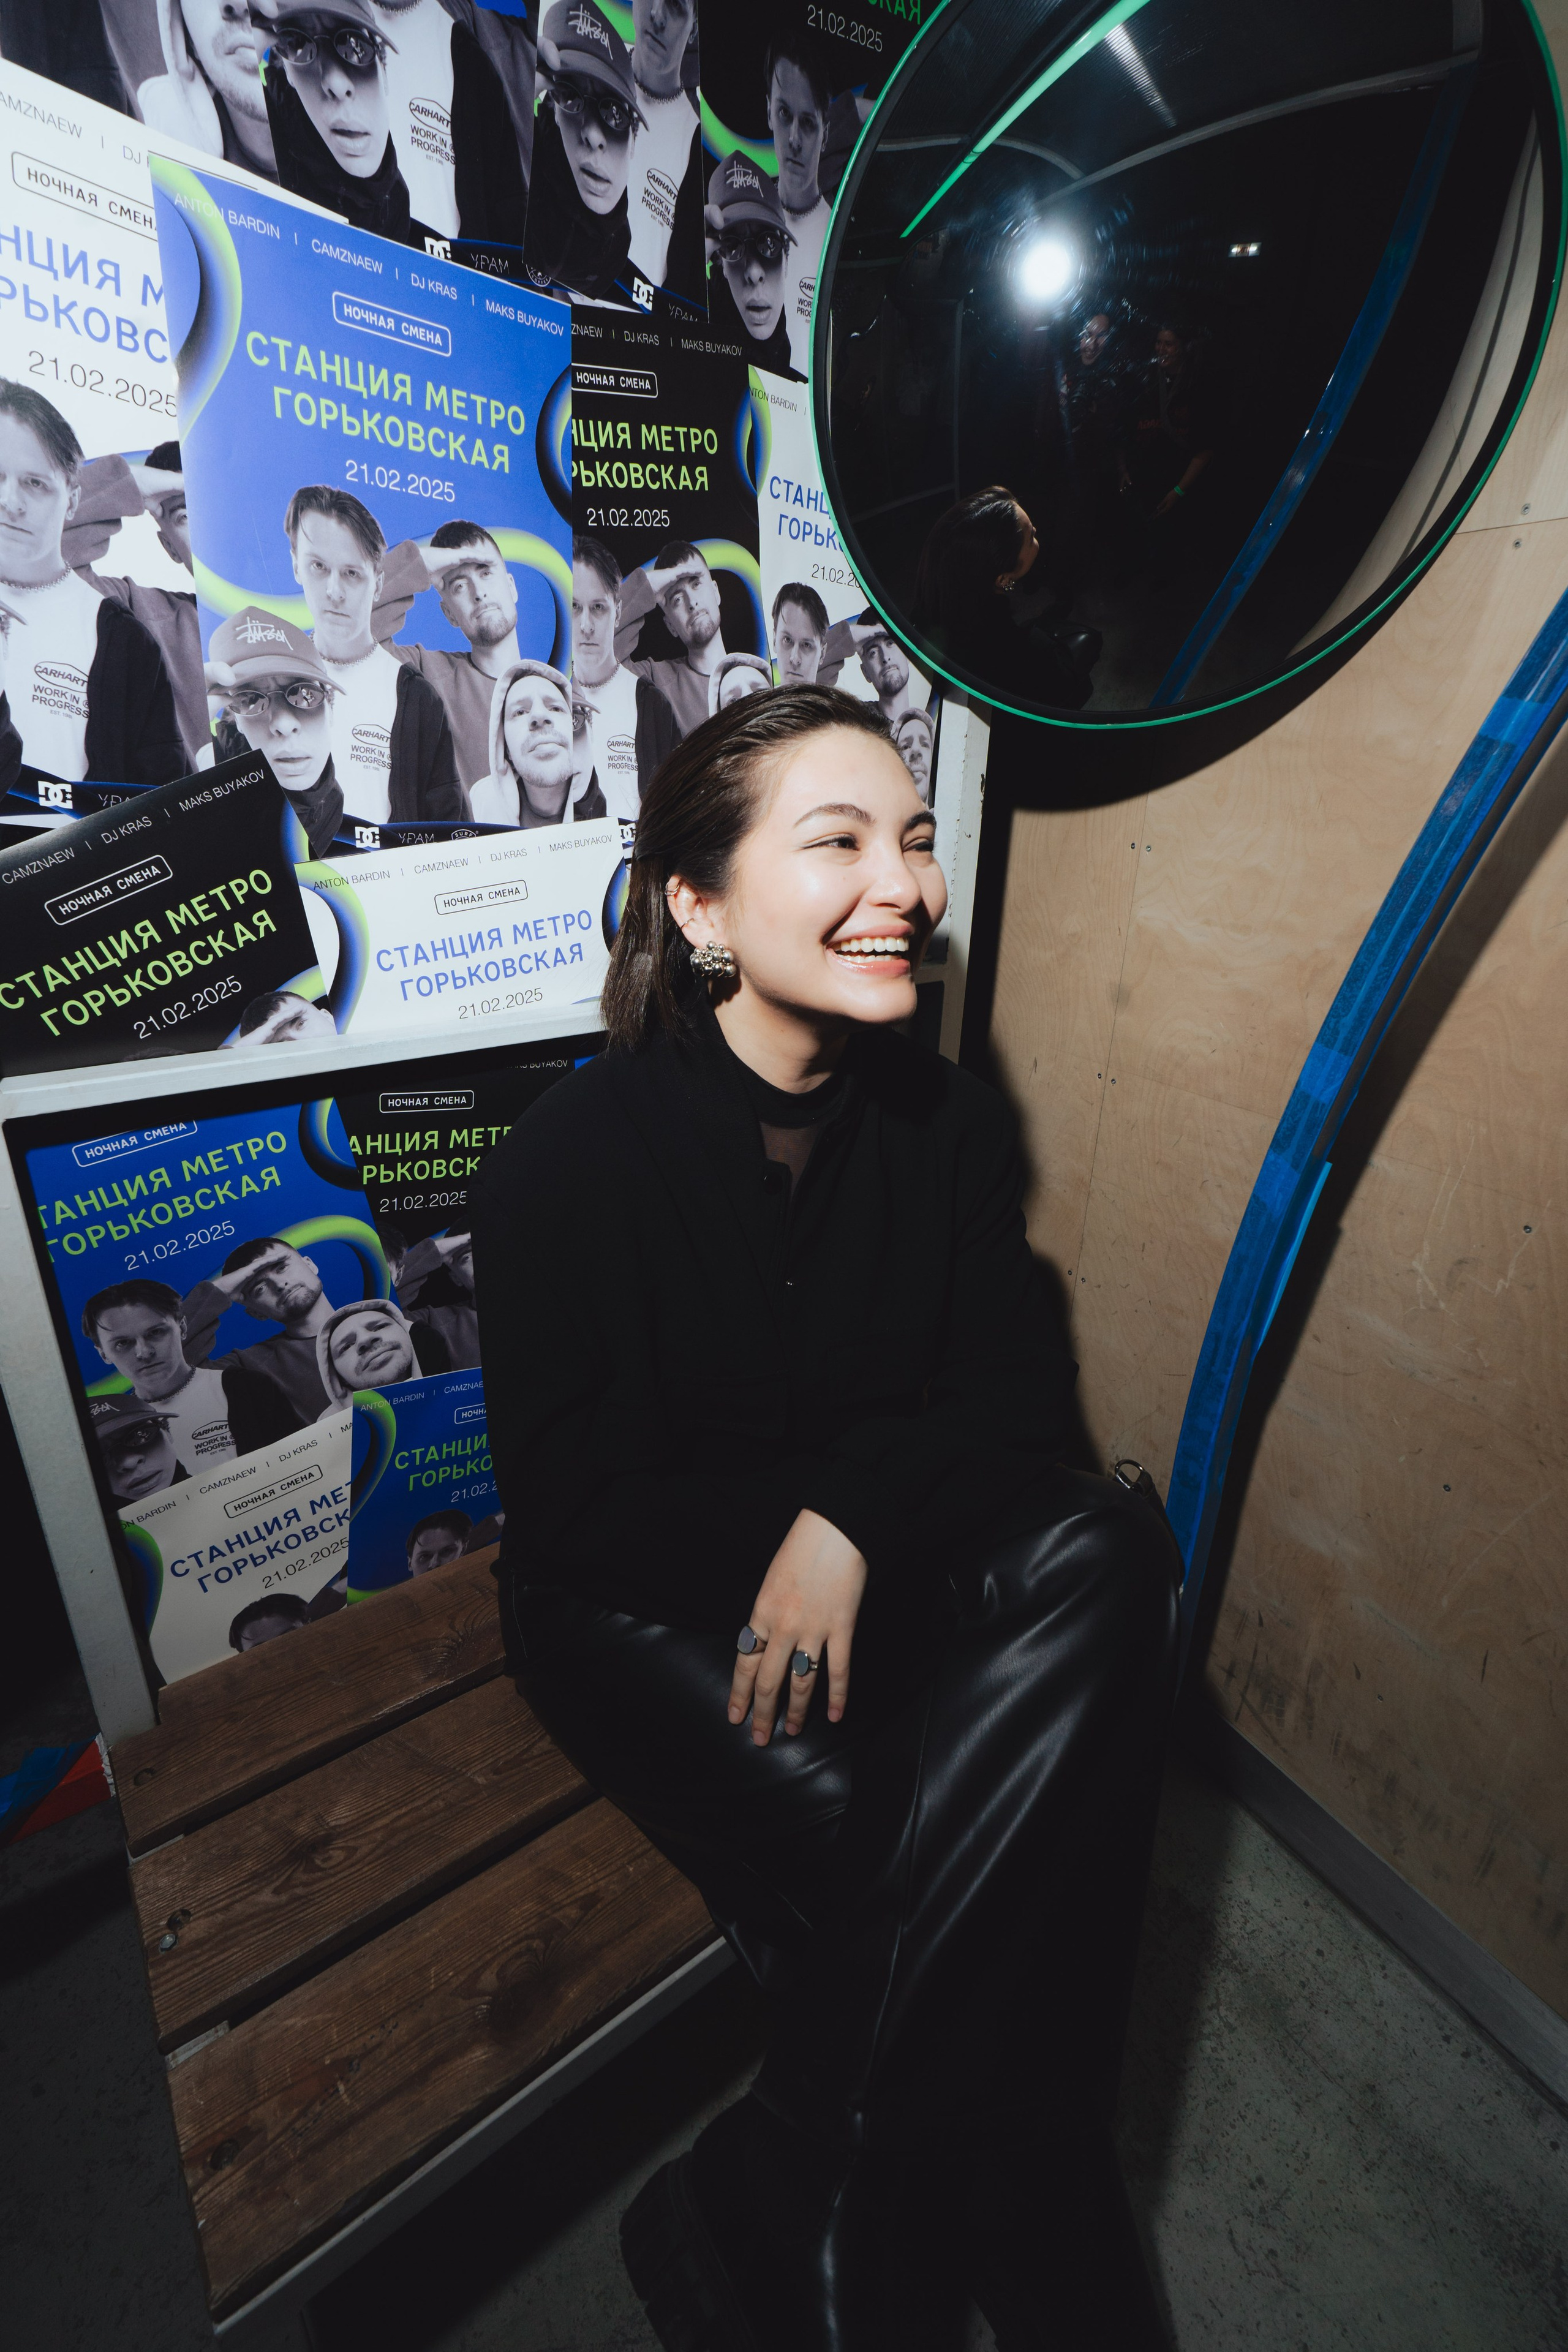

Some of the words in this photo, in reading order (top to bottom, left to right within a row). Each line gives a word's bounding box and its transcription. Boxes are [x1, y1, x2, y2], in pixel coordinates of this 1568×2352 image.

[807, 4, 883, 52] 21.02.2025
[123, 145, 141, 164] DJ
[410, 124, 438, 143] WORK
[439, 136, 447, 148] IN
[411, 136, 456, 165] PROGRESS
[28, 167, 97, 206] НОЧНАЯ
[109, 201, 157, 231] СМЕН
[642, 196, 674, 230] PROGRESS
[644, 187, 665, 208] WORK
[665, 204, 671, 216] IN
[175, 193, 224, 221] ANTON
[229, 211, 279, 239] BARDIN
[311, 239, 382, 274] CAMZNAEW
[411, 273, 425, 289] DJ
[428, 279, 457, 300] KRAS
[486, 300, 514, 320] MAKS
[517, 311, 564, 336] BUYAKOV
[344, 303, 394, 331] НОЧНАЯ
[401, 322, 442, 346] СМЕНА
[624, 331, 635, 342] DJ
[637, 332, 660, 346] KRAS
[681, 338, 704, 352] MAKS
[706, 342, 742, 356] BUYAKOV
[29, 350, 177, 417] 21.02.2025
[246, 331, 412, 405] СТАНЦИЯ
[425, 381, 526, 435] МЕТРО
[576, 372, 615, 386] НОЧНАЯ
[620, 376, 651, 390] СМЕНА
[771, 394, 797, 412] BARDIN
[273, 386, 510, 473] ГОРЬКОВСКАЯ
[641, 424, 718, 454] МЕТРО
[345, 460, 456, 502] 21.02.2025
[587, 508, 670, 527] 21.02.2025
[778, 513, 843, 552] ГОРЬК
[32, 695, 89, 718] PROGRESS
[33, 684, 68, 699] WORK
[70, 693, 80, 704] IN
[350, 753, 392, 769] PROGRESS
[352, 745, 377, 755] WORK
[377, 749, 385, 758] IN
[608, 763, 639, 772] PROGRESS
[2, 847, 75, 884] CAMZNAEW
[101, 829, 119, 843] DJ
[118, 816, 152, 837] KRAS
[179, 791, 213, 812] MAKS
[212, 769, 264, 798] BUYAKOV
[313, 876, 349, 891] ANTON
[351, 870, 391, 884] BARDIN
[414, 858, 469, 875] CAMZNAEW
[490, 853, 502, 862] DJ
[503, 848, 527, 859] KRAS
[549, 841, 573, 852] MAKS
[575, 835, 612, 848] BUYAKOV
[58, 885, 113, 915] НОЧНАЯ
[116, 865, 161, 890] СМЕНА
[443, 893, 483, 908] НОЧНАЯ
[488, 887, 521, 899] СМЕНА
[0, 919, 162, 1009] СТАНЦИЯ
[165, 869, 273, 935] МЕТРО
[375, 927, 503, 972] СТАНЦИЯ
[512, 910, 593, 945] МЕТРО
[39, 909, 277, 1036] ГОРЬКОВСКАЯ
[400, 943, 584, 1001] ГОРЬКОВСКАЯ
[133, 975, 242, 1039] 21.02.2025
[458, 987, 543, 1020] 21.02.2025
[388, 1098, 428, 1107] НОЧНАЯ
[434, 1096, 467, 1105] СМЕНА
[85, 1136, 138, 1159] НОЧНАЯ
[143, 1122, 187, 1141] СМЕНА
[181, 1131, 287, 1182] МЕТРО
[379, 1191, 467, 1213] 21.02.2025
[124, 1221, 235, 1270] 21.02.2025
[360, 1400, 390, 1411] ANTON
[393, 1392, 424, 1404] BARDIN
[194, 1436, 219, 1449] WORK
[195, 1440, 236, 1456] PROGRESS
[394, 1433, 490, 1469] СТАНЦИ
[136, 1501, 176, 1523] BARDIN
[200, 1466, 256, 1494] CAMZNAEW
[279, 1452, 292, 1462] DJ
[293, 1439, 318, 1455] KRAS
[233, 1489, 276, 1512] НОЧНАЯ
[280, 1472, 315, 1491] СМЕНА
[170, 1507, 301, 1577] СТАНЦИЯ
[262, 1537, 349, 1589] 21.02.2025
